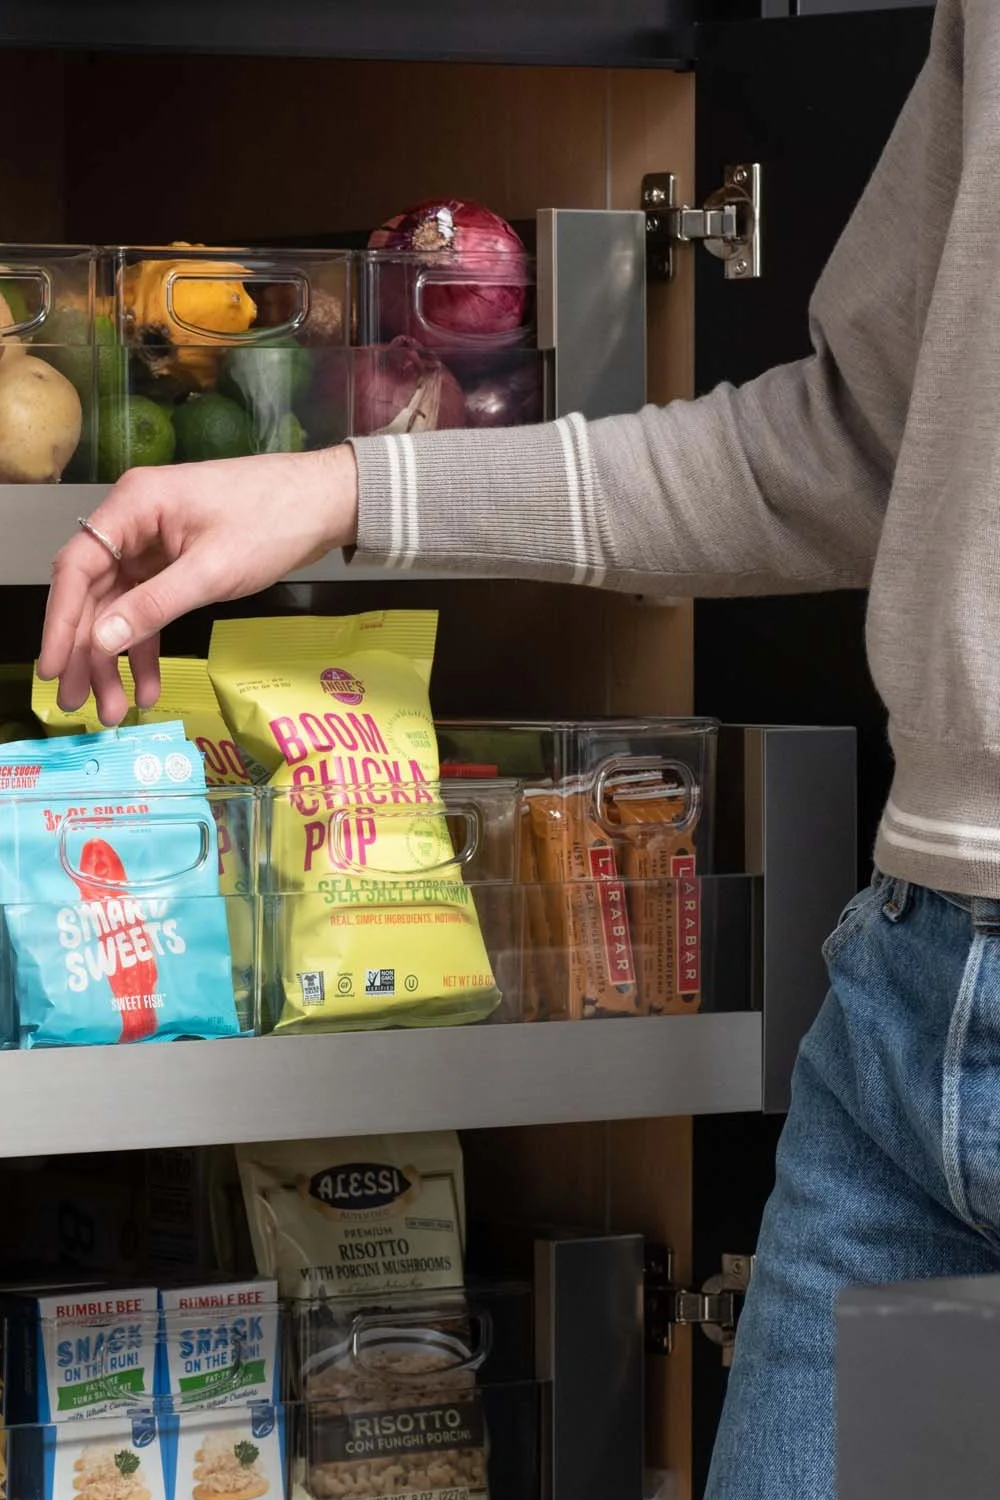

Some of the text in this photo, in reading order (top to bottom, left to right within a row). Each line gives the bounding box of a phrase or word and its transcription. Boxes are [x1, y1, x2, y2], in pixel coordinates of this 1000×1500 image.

[320, 680, 366, 694] ANGIE'S
[269, 712, 389, 766] BOOM
[10, 776, 37, 789] CANDY
[14, 765, 41, 776] SUGAR
[290, 757, 434, 816] CHICKA
[304, 809, 377, 873] POP
[318, 879, 360, 904] SEA
[360, 879, 402, 902] SALT
[598, 856, 630, 971] LARABAR
[678, 866, 697, 980] LARABAR
[65, 919, 187, 992] SWEETS
[443, 976, 457, 988] NET
[111, 994, 166, 1012] SWEET FISH
[316, 1170, 400, 1200] ALESSI
[344, 1226, 393, 1239] PREMIUM
[338, 1238, 410, 1261] RISOTTO
[300, 1255, 451, 1281] WITH PORCINI MUSHROOMS
[56, 1298, 143, 1318] BUMBLE BEE
[236, 1291, 264, 1305] BEE
[56, 1324, 143, 1368] SNACK
[64, 1354, 139, 1382] ON TH RUN!
[184, 1359, 201, 1373] ON
[204, 1352, 227, 1369] THE
[354, 1409, 461, 1438] RISOTTO
[345, 1430, 472, 1454] CON FUNGHI PORCINI
